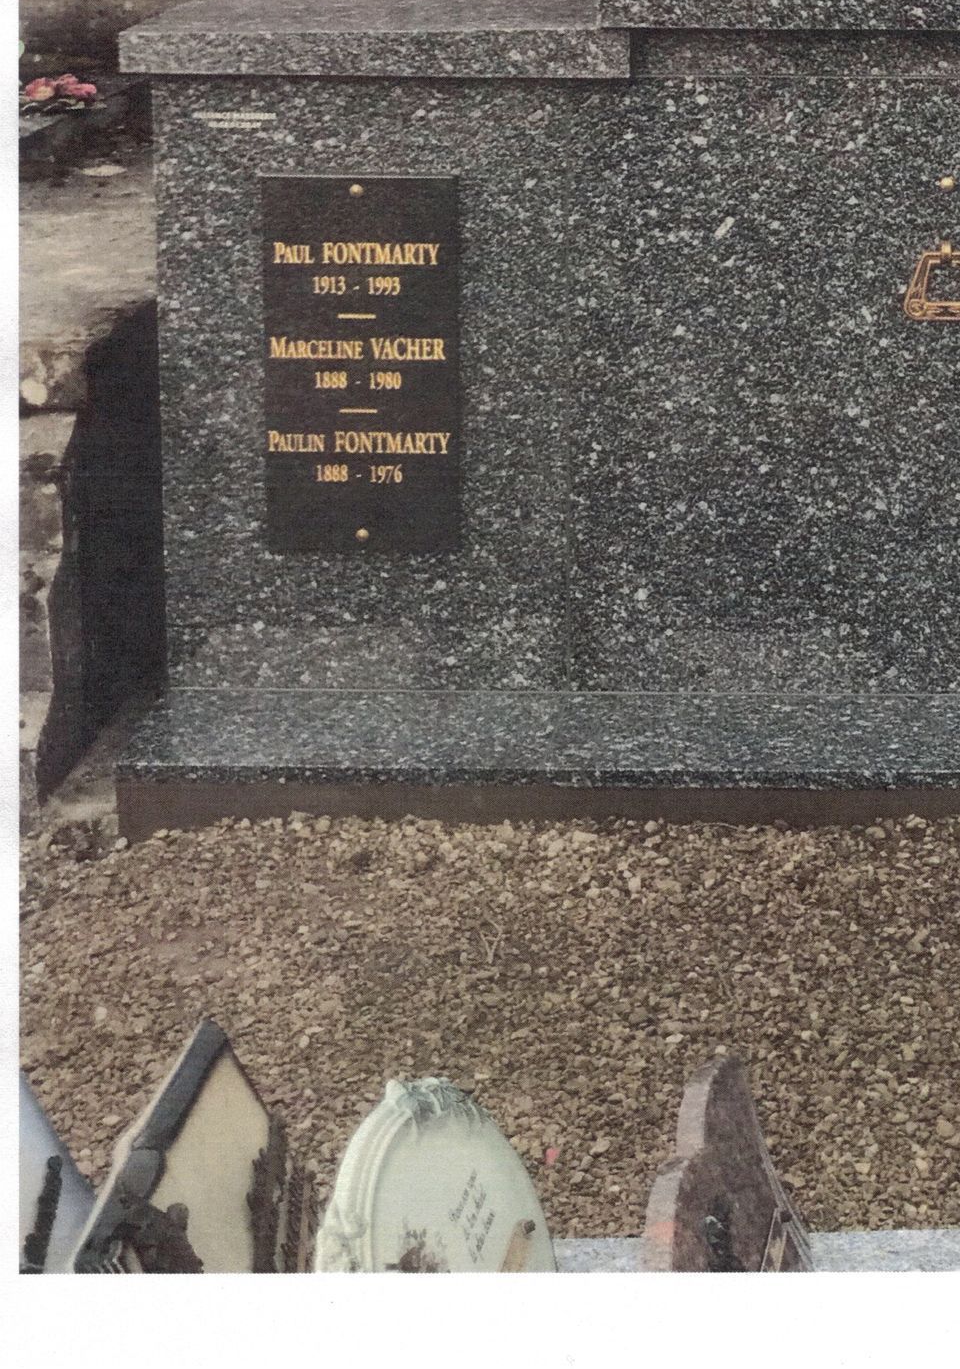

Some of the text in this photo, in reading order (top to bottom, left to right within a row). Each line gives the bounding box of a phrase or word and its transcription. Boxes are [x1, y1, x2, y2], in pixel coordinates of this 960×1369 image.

[322, 242, 440, 266] FONTMARTY
[312, 276, 346, 295] 1913
[367, 276, 401, 295] 1993
[369, 338, 446, 360] VACHER
[315, 371, 348, 389] 1888
[369, 371, 402, 390] 1980
[335, 431, 451, 455] FONTMARTY
[316, 464, 348, 483] 1888
[369, 464, 403, 484] 1976
